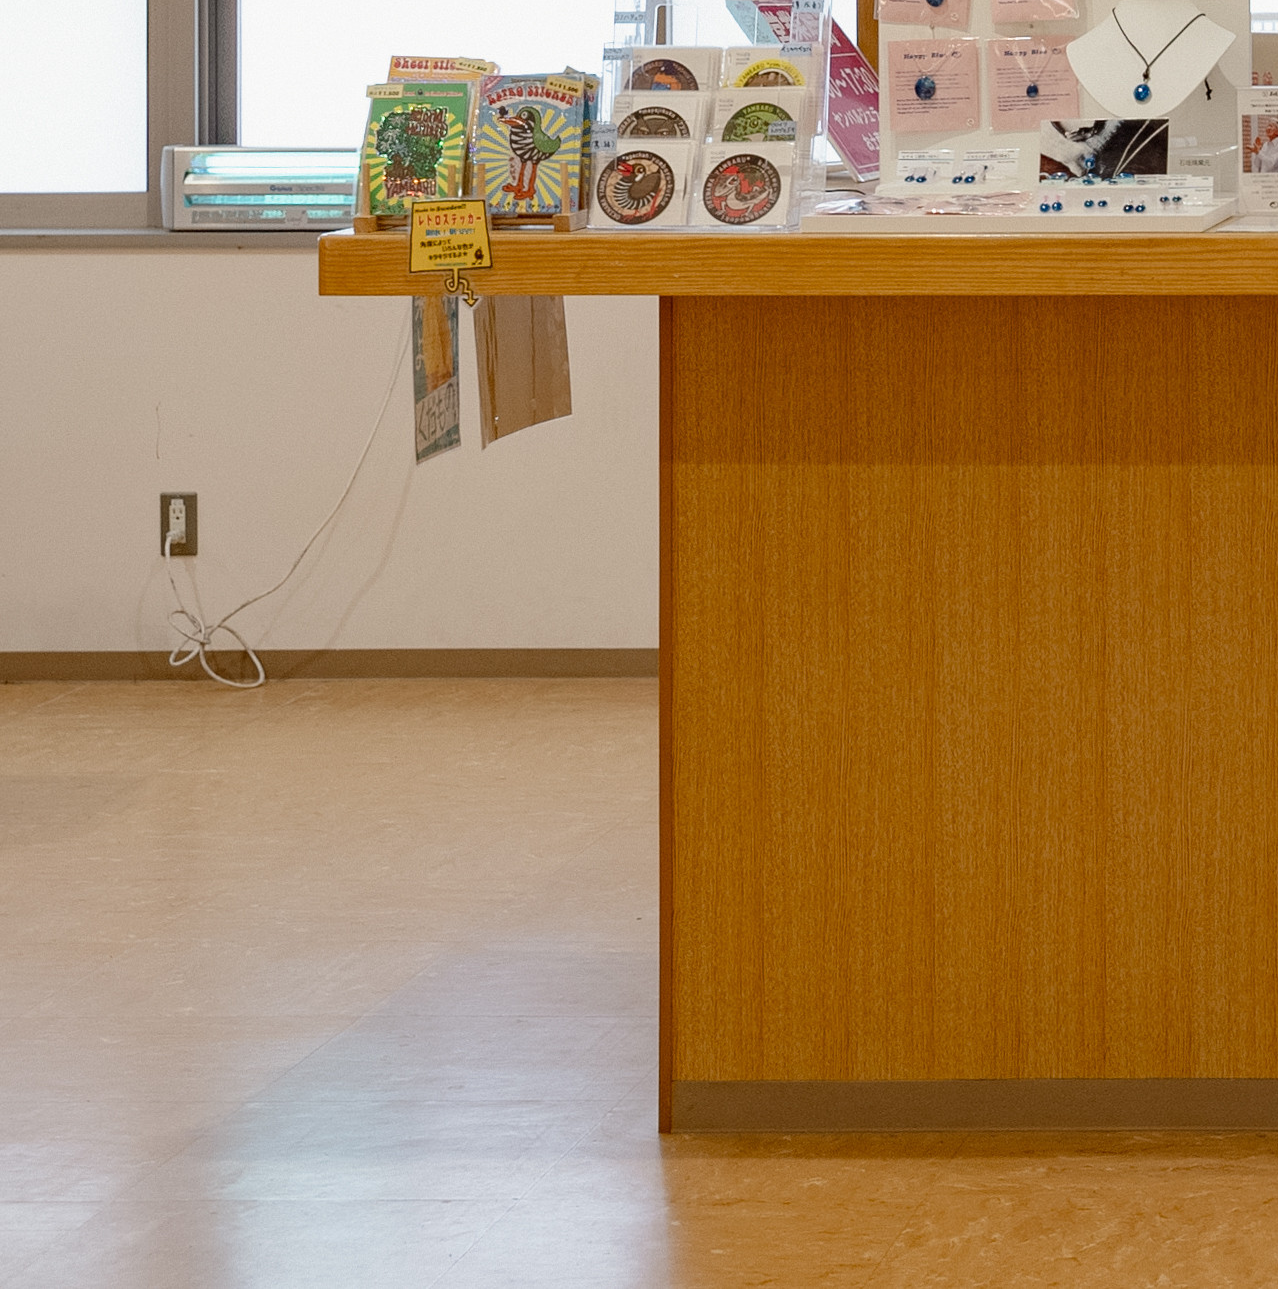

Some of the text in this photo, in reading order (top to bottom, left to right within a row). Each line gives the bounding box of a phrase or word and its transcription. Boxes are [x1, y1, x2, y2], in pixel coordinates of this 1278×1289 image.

[418, 212, 482, 226] レトロステッカー
